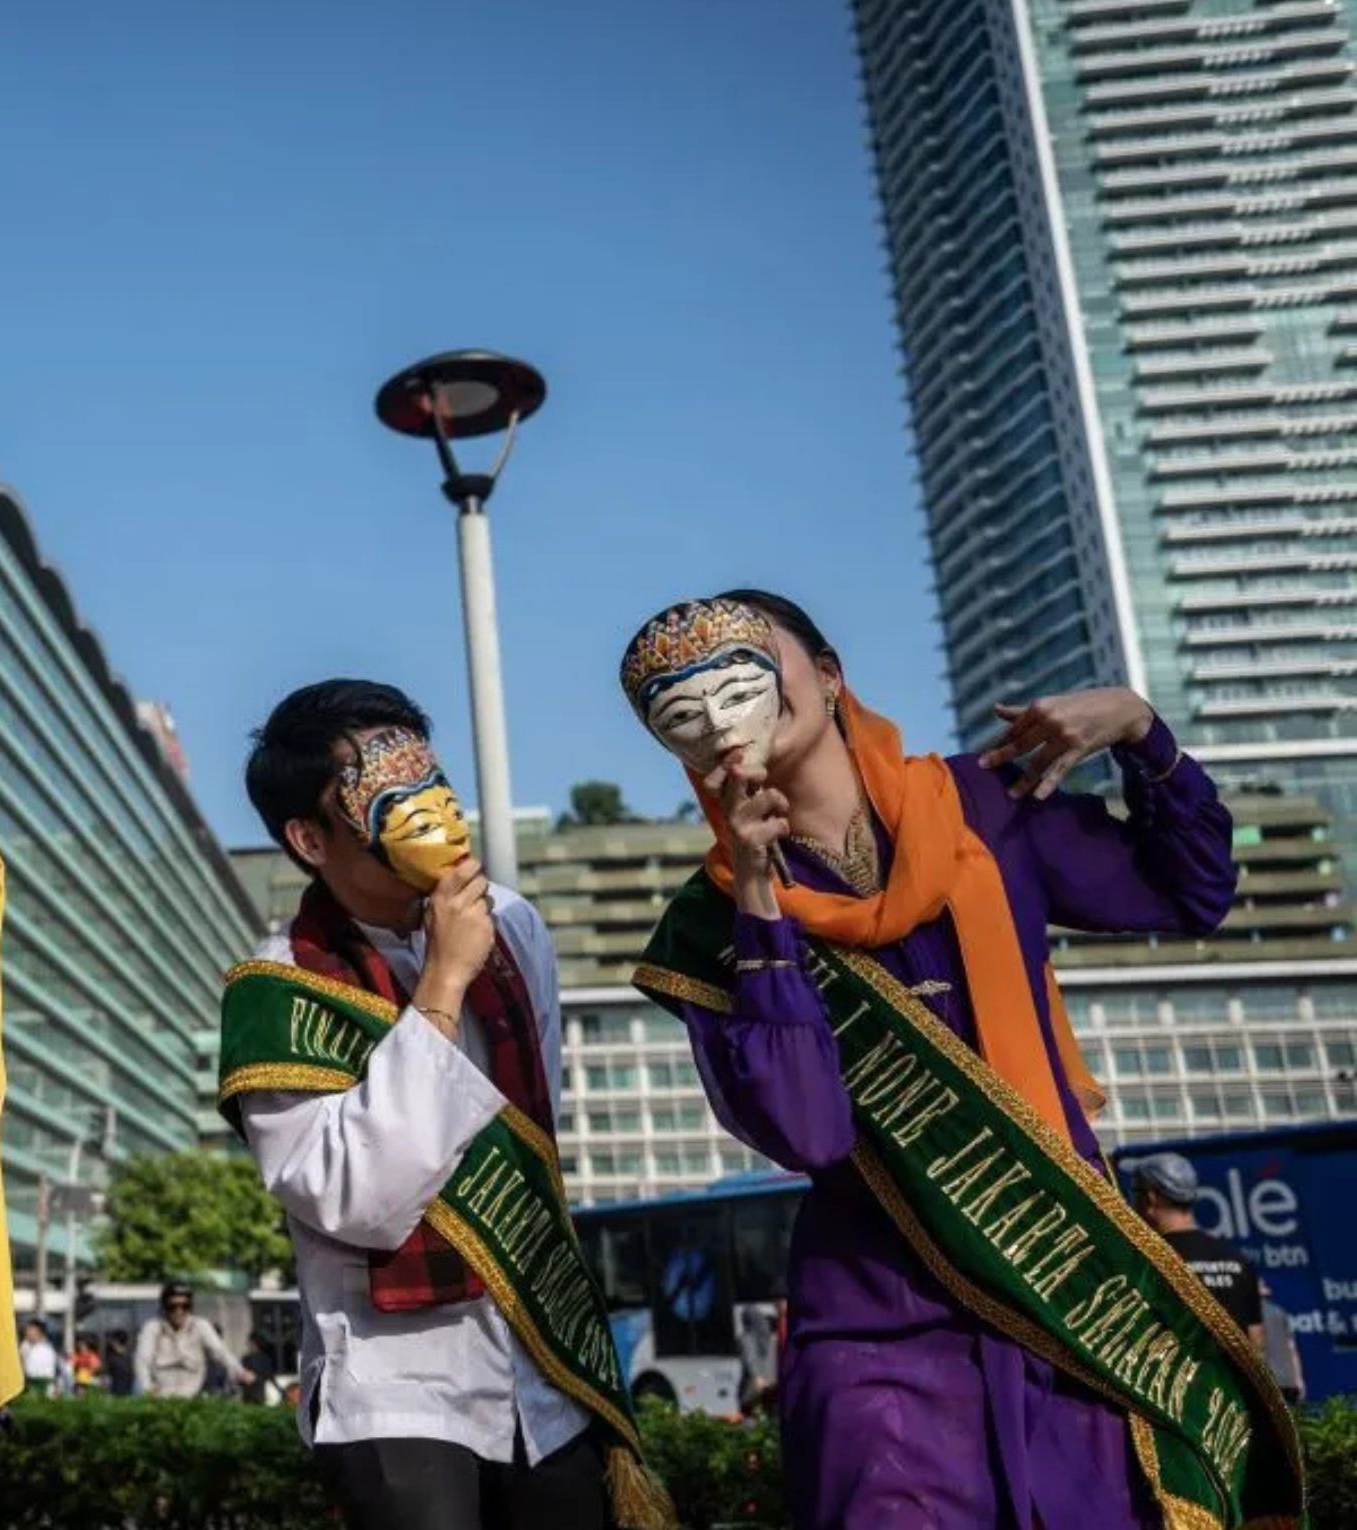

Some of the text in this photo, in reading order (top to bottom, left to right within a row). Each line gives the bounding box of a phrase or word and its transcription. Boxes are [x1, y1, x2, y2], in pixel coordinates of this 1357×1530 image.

[841, 1031, 960, 1149] NONE
[927, 1126, 1096, 1302] JAKARTA
[1063, 1274, 1201, 1424] SELATAN
[1194, 1160, 1299, 1238] alé
[1263, 1243, 1310, 1268] btn
